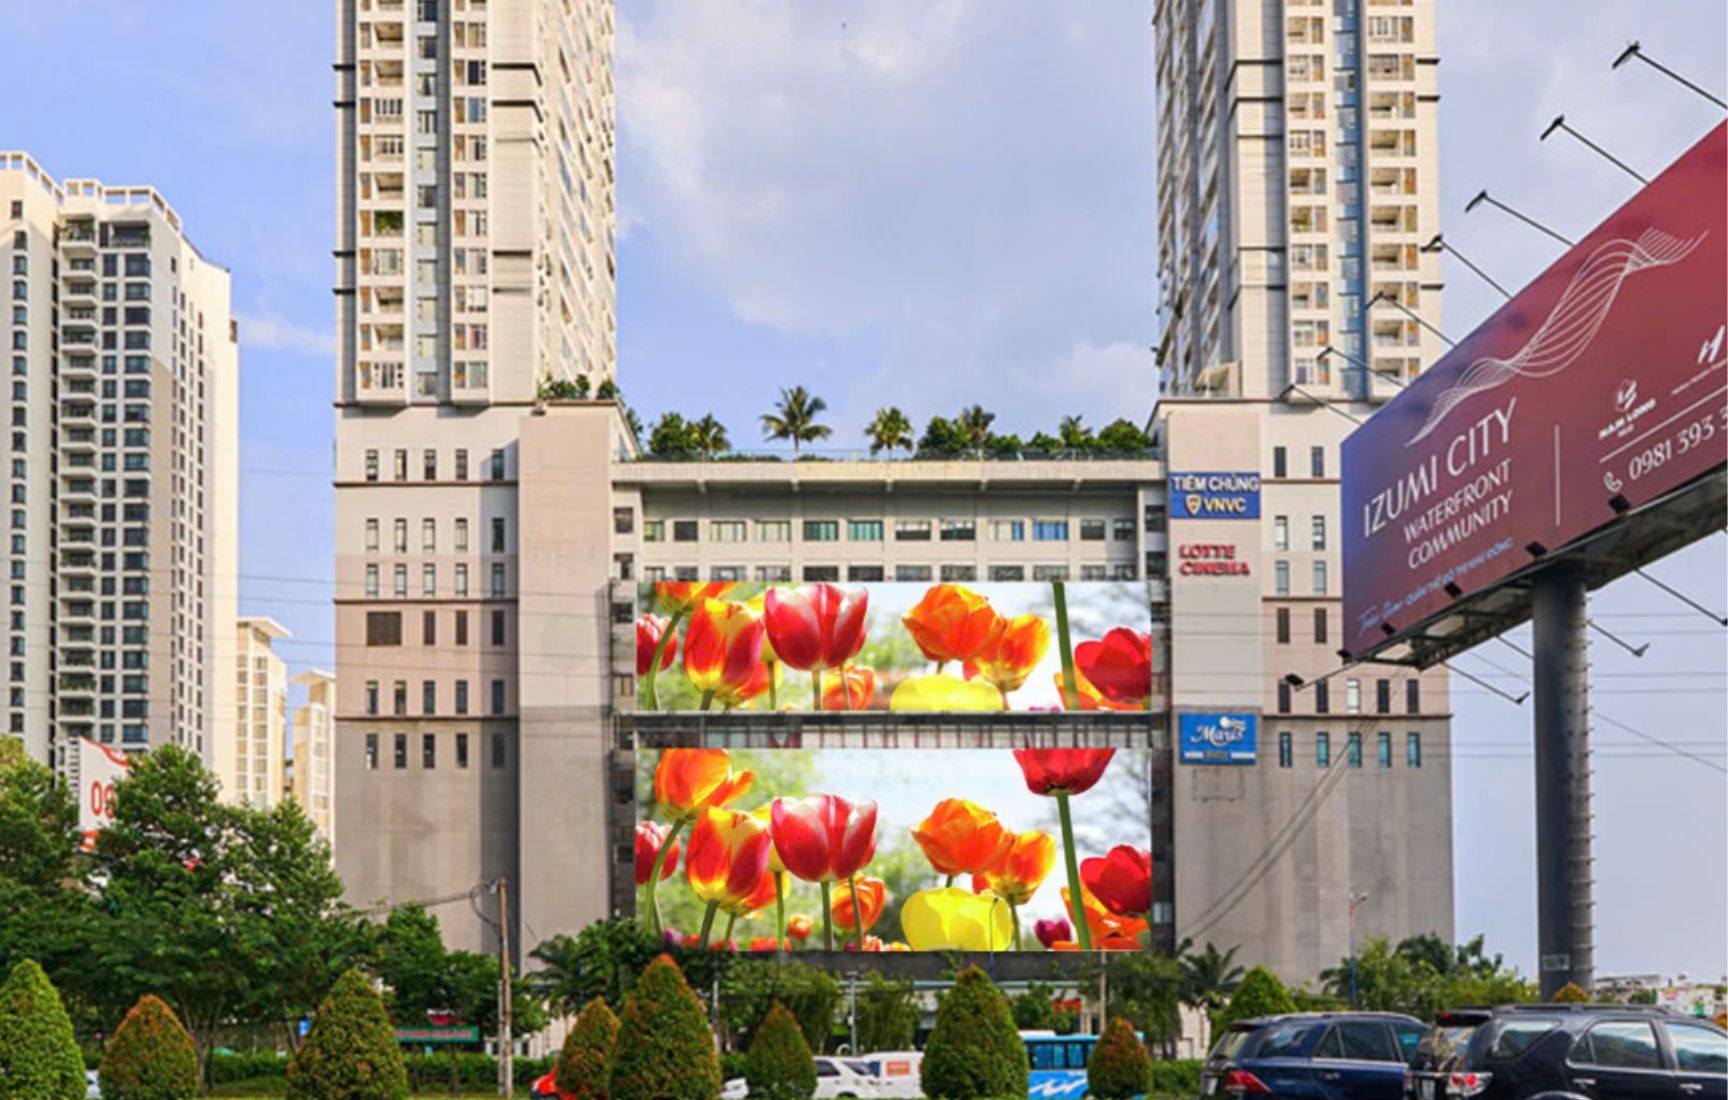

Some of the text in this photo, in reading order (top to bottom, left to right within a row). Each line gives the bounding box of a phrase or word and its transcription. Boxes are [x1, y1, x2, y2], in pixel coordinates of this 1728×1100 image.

[1363, 397, 1517, 538] IZUMI CITY
[1628, 438, 1672, 480] 0981
[1677, 414, 1715, 455] 393
[1203, 497, 1247, 513] VNVC
[1403, 457, 1512, 544] WATERFRONT
[1408, 489, 1513, 570] COMMUNITY
[1179, 544, 1235, 560] LOTTE
[1179, 560, 1250, 576] CINEMA
